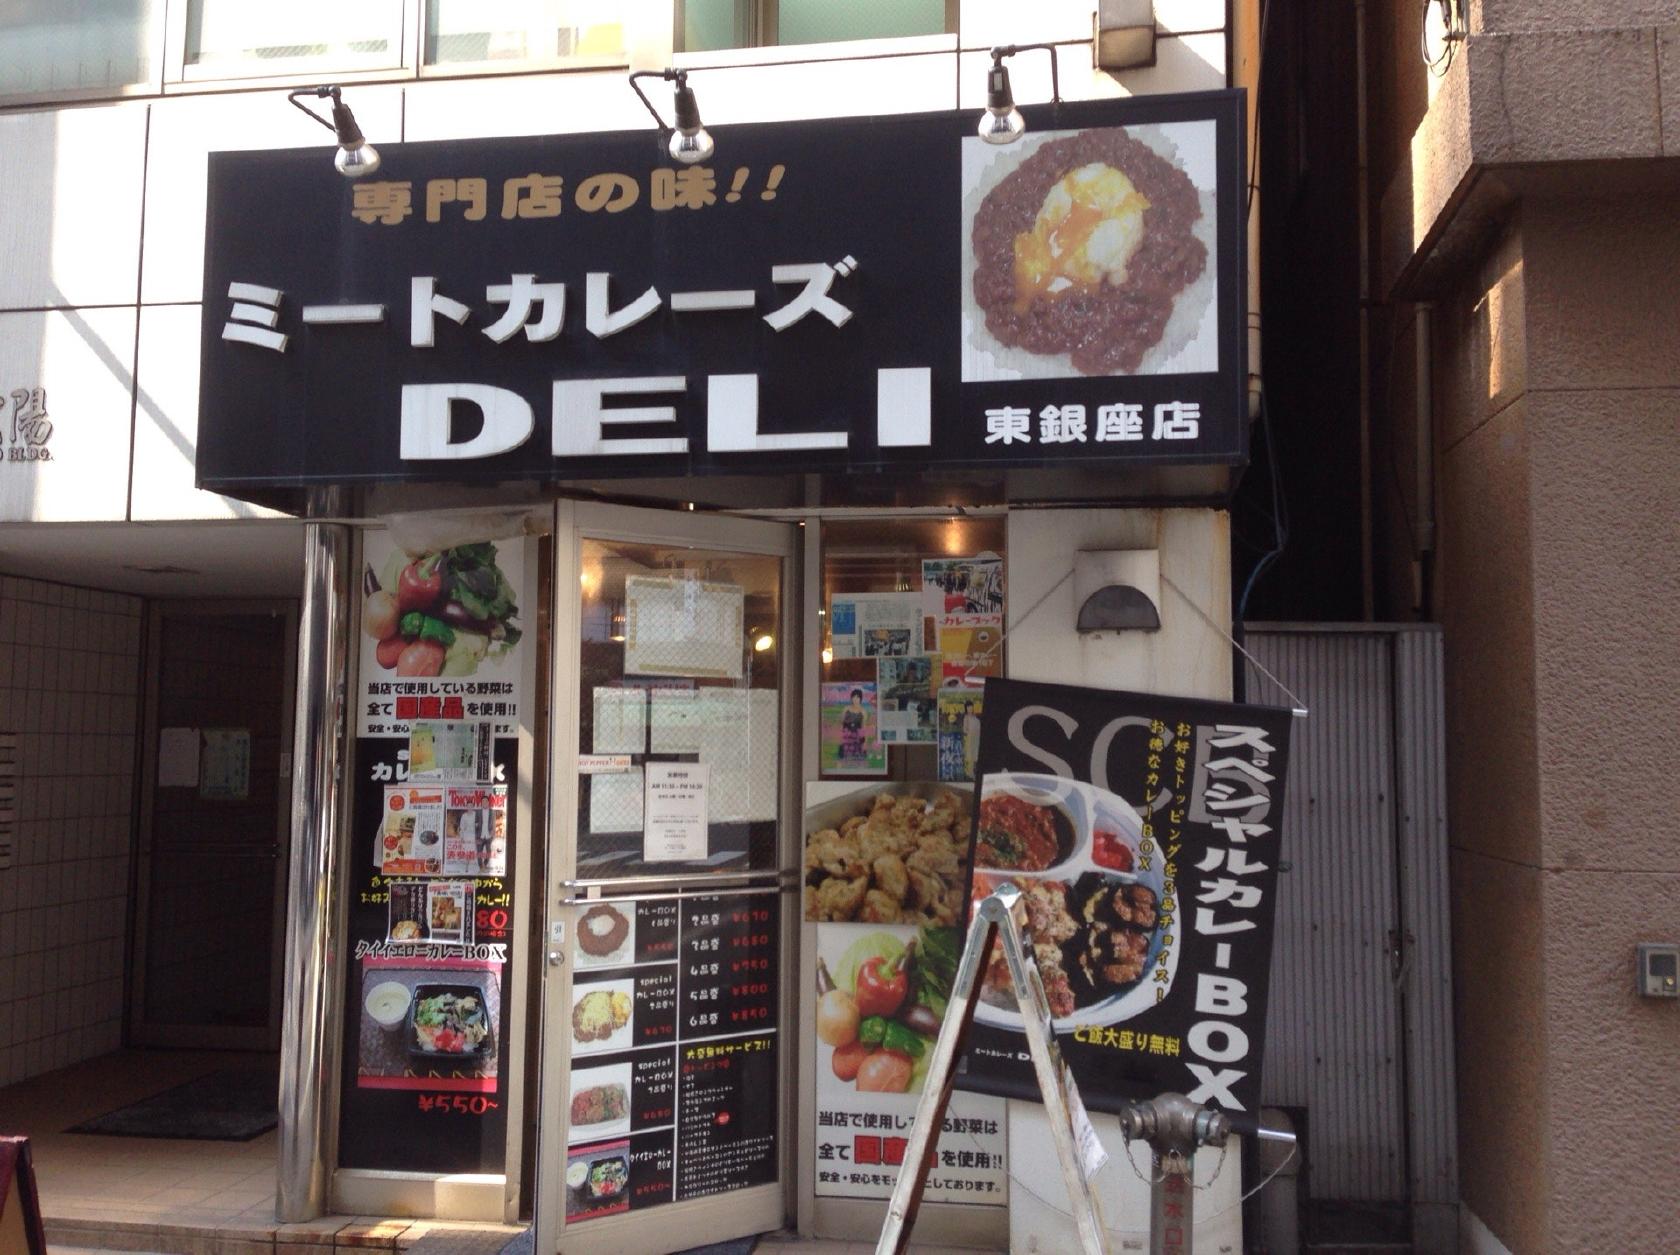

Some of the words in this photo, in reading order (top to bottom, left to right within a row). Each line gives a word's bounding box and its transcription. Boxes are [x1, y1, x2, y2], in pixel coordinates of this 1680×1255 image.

[352, 165, 786, 225] 専門店の味!!
[221, 254, 860, 353] ミートカレーズ
[399, 366, 932, 460] DELI
[984, 401, 1202, 446] 東銀座店
[368, 682, 514, 696] 当店で使用している野菜は
[1138, 719, 1165, 871] お得なカレーBOX
[1185, 723, 1277, 1112] スペシャルカレーBOX
